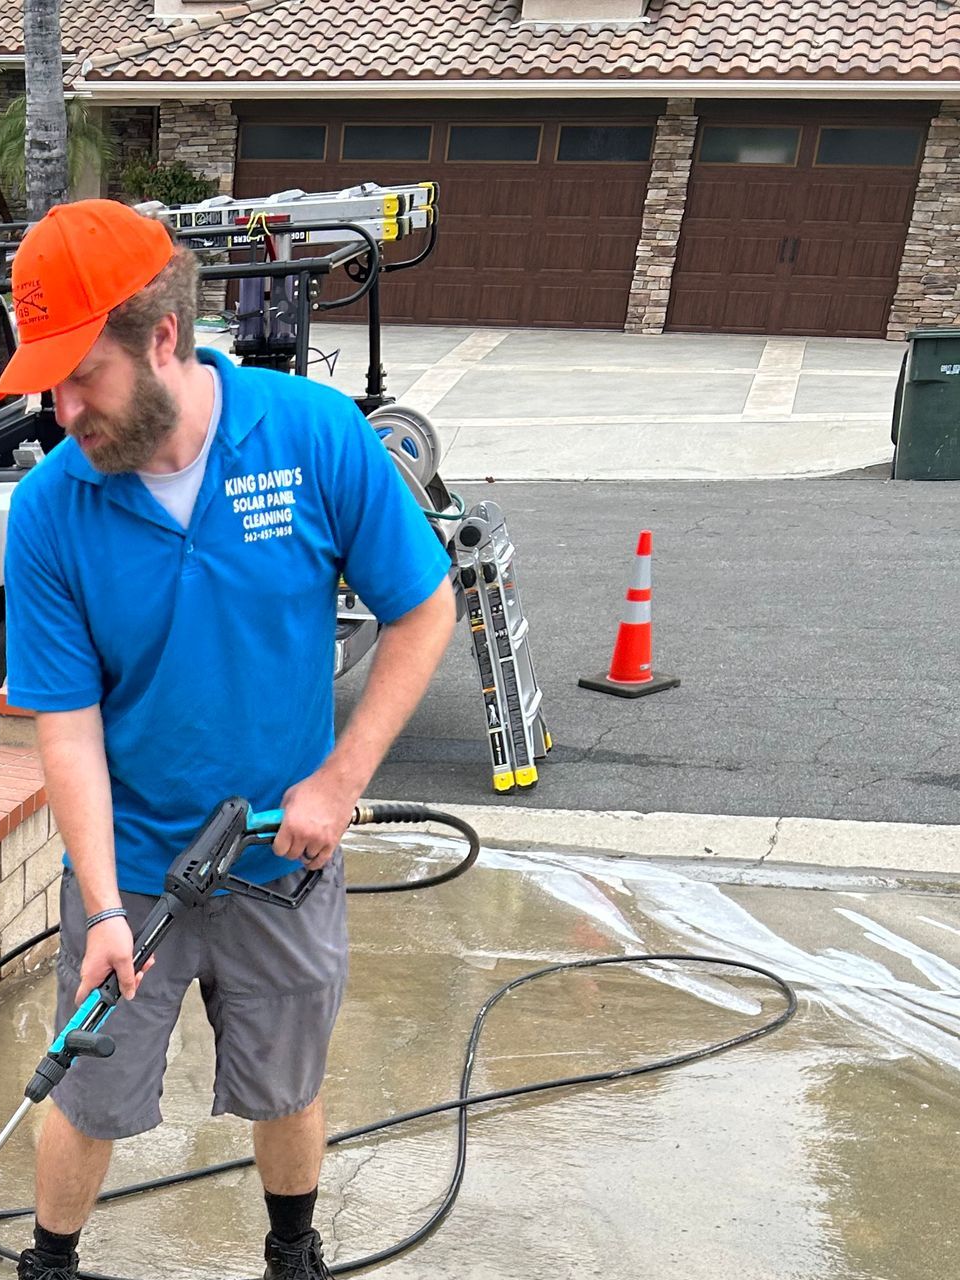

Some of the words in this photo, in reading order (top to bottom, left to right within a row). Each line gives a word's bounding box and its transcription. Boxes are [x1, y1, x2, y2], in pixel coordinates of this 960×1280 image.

[225, 474, 256, 496] KING
[258, 467, 303, 491] DAVID'S
[233, 495, 265, 513] SOLAR
[267, 490, 296, 507] PANEL
[243, 508, 292, 530] CLEANING
